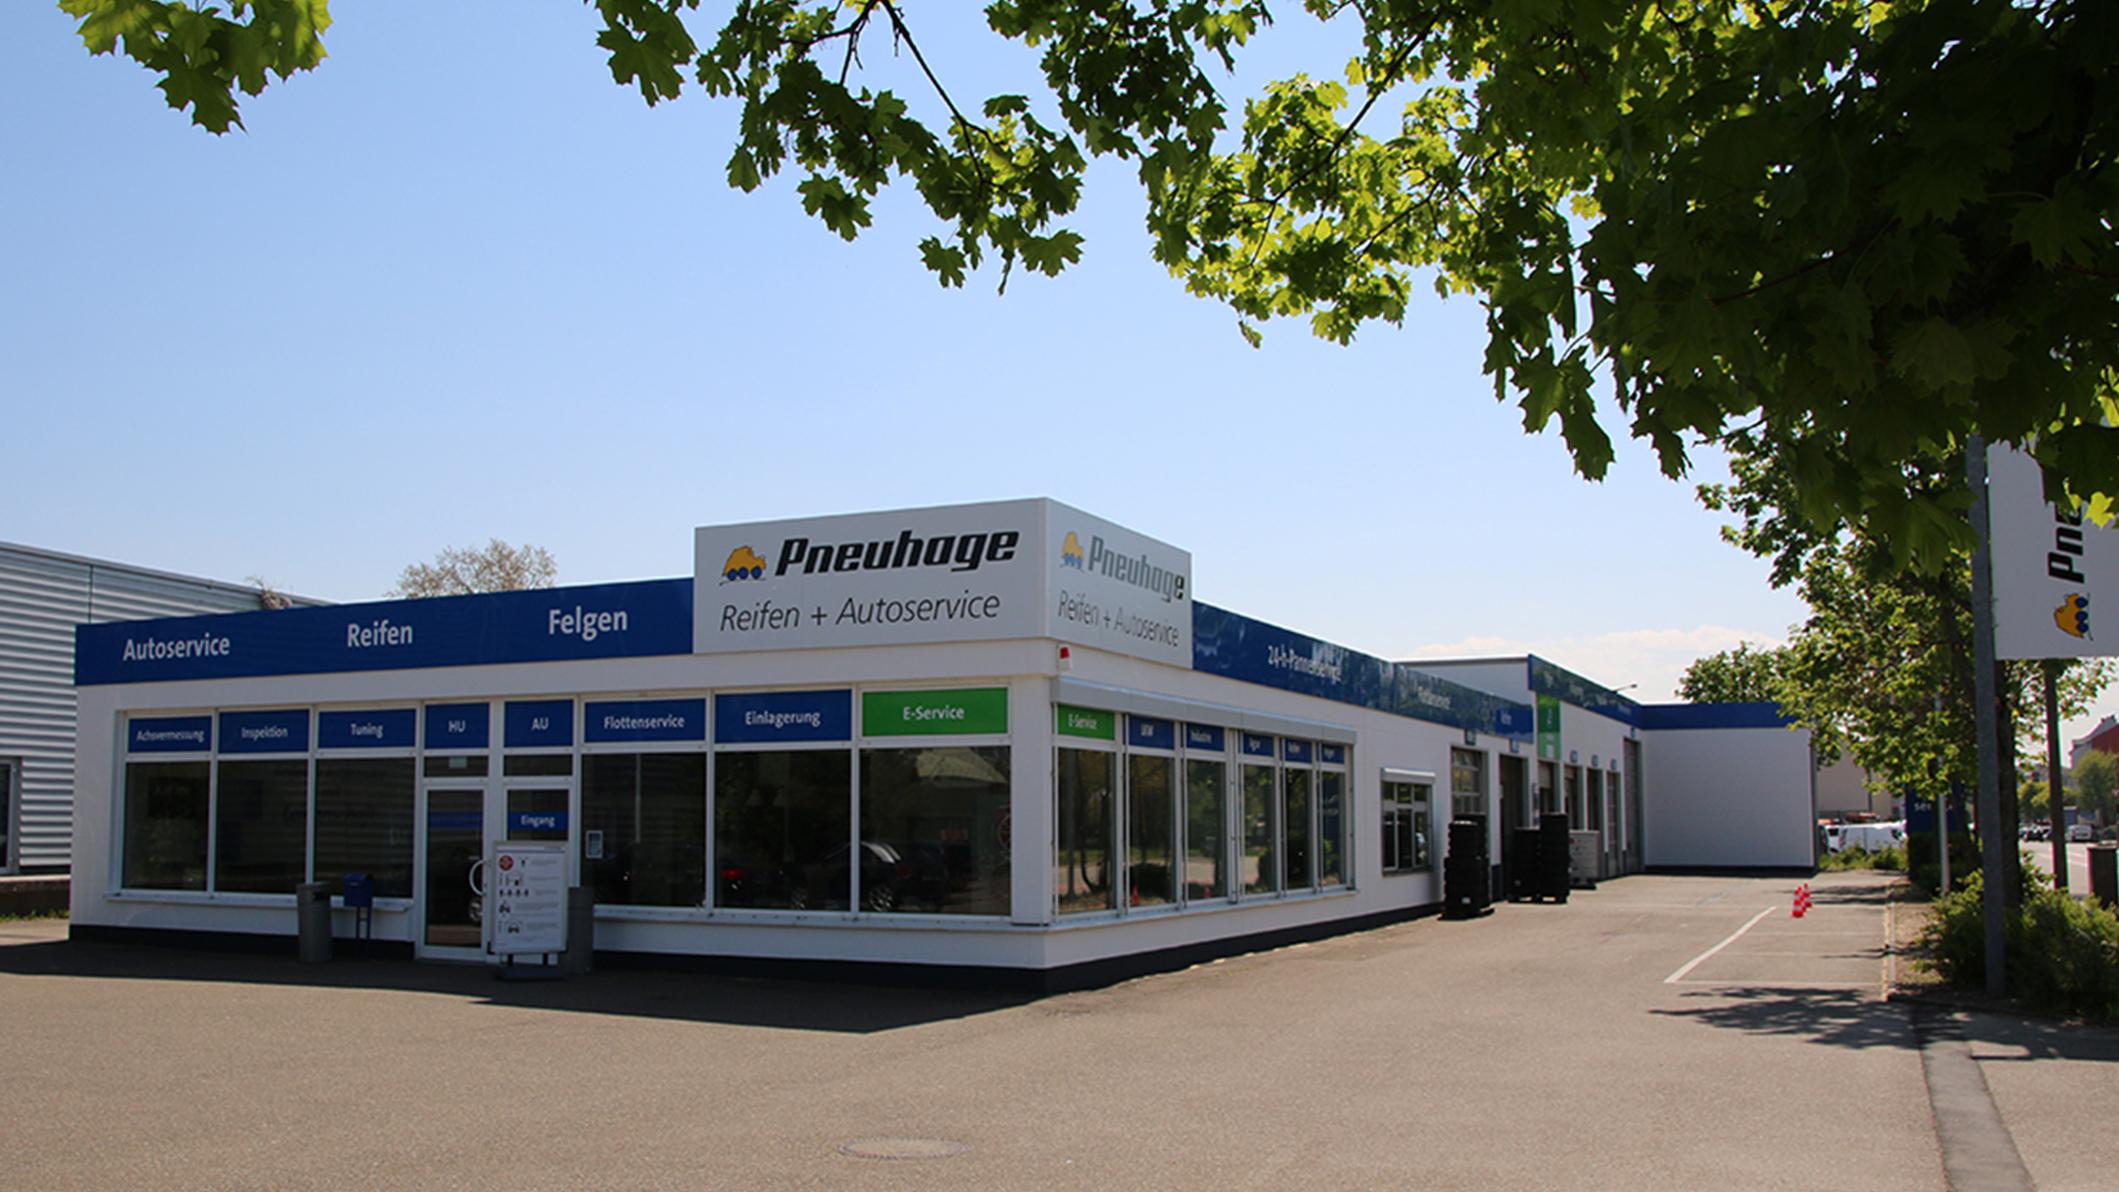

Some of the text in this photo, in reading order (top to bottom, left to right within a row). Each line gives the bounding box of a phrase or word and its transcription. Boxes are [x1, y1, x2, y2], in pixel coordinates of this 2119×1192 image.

[775, 530, 1019, 576] Pneuhage
[1088, 535, 1186, 603] Pneuhage
[719, 590, 1001, 632] Reifen + Autoservice
[1057, 590, 1099, 626] Reifen
[1112, 605, 1180, 648] Autoservice
[549, 606, 628, 641] Felgen
[347, 619, 413, 648] Reifen
[122, 632, 230, 661] Autoservice
[745, 710, 821, 728] Einlagerung
[902, 704, 965, 721] E-Service
[350, 722, 384, 738] Tuning
[448, 720, 466, 733] HU
[531, 717, 549, 730] AU
[603, 714, 685, 730] Flottenservice
[241, 726, 289, 740] Inspektion
[520, 814, 555, 828] Eingang
